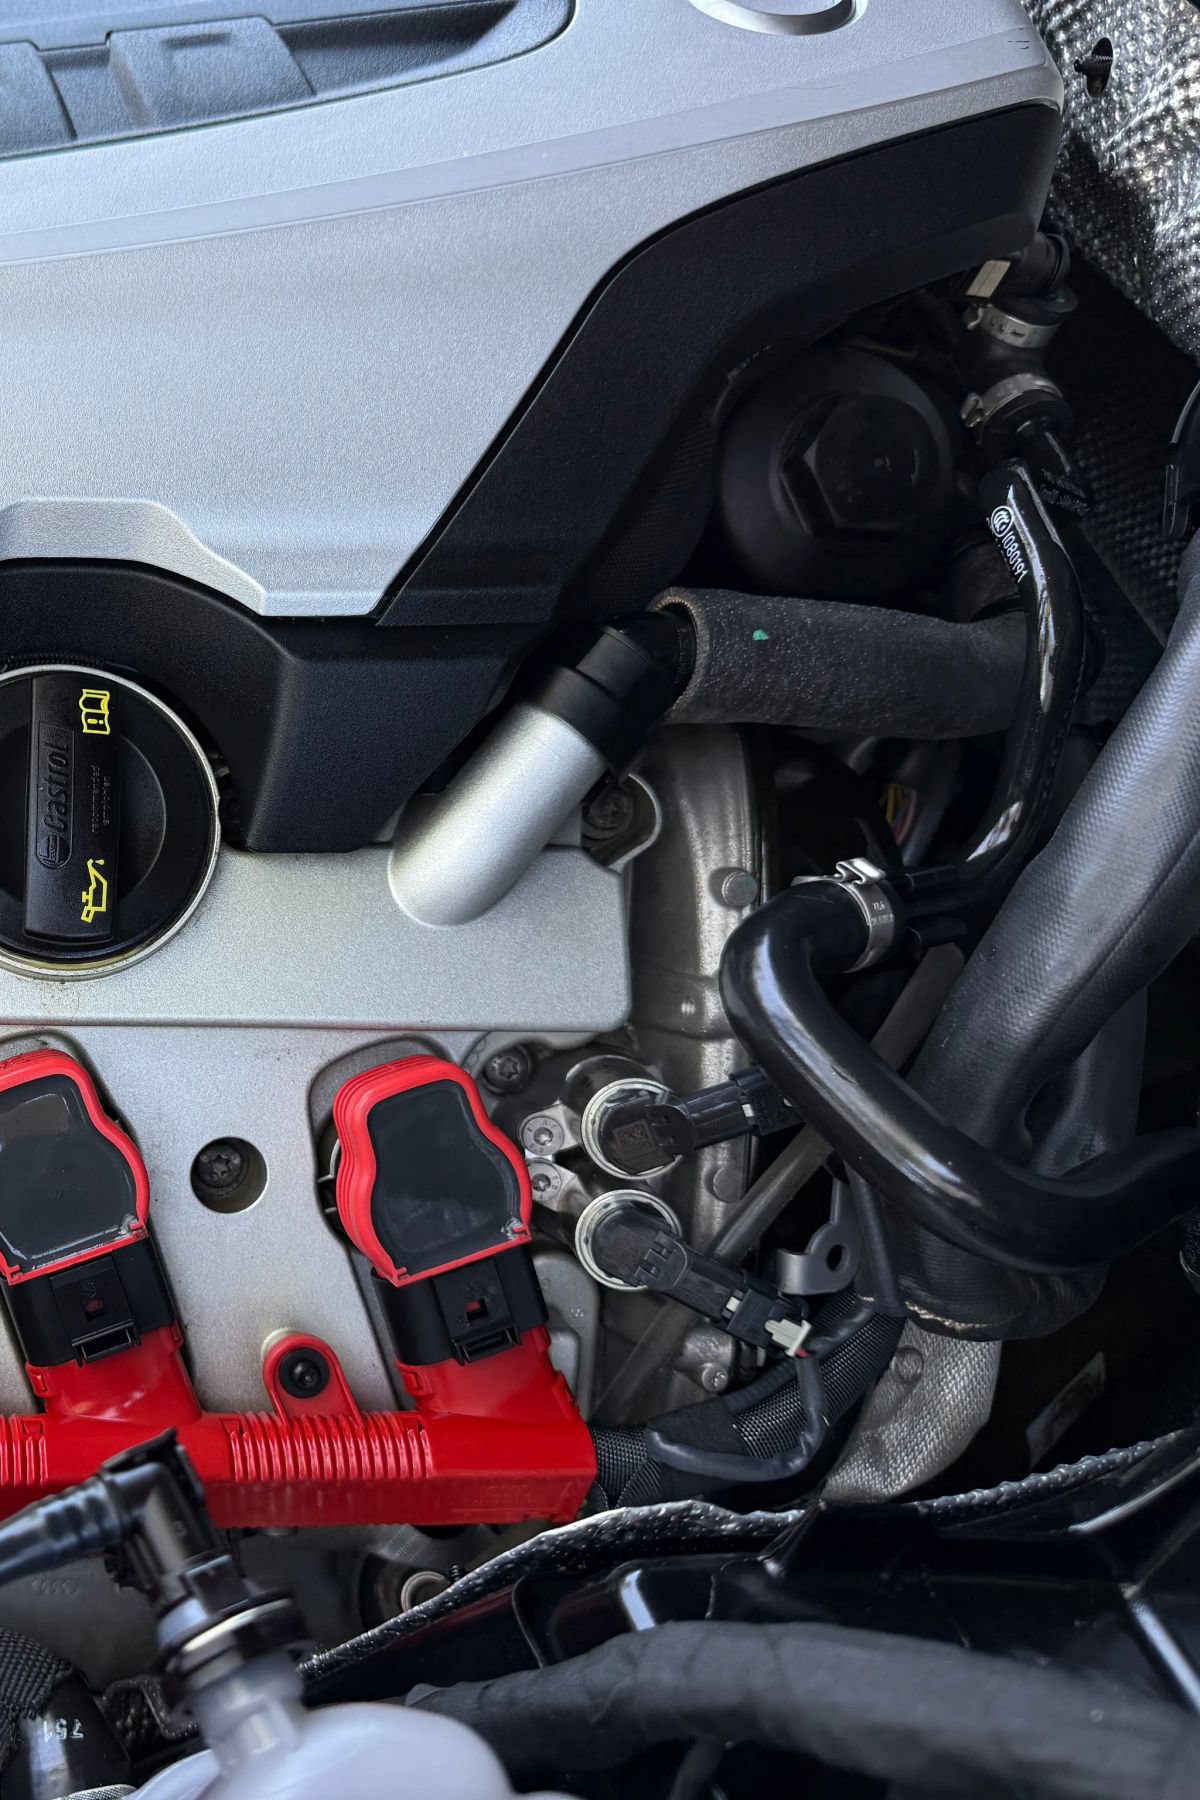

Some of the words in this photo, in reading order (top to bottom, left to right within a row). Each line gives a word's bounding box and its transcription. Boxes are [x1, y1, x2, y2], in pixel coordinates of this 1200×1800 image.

[42, 742, 69, 832] Castrol
[91, 764, 101, 833] recommended
[43, 1718, 84, 1743] 751
